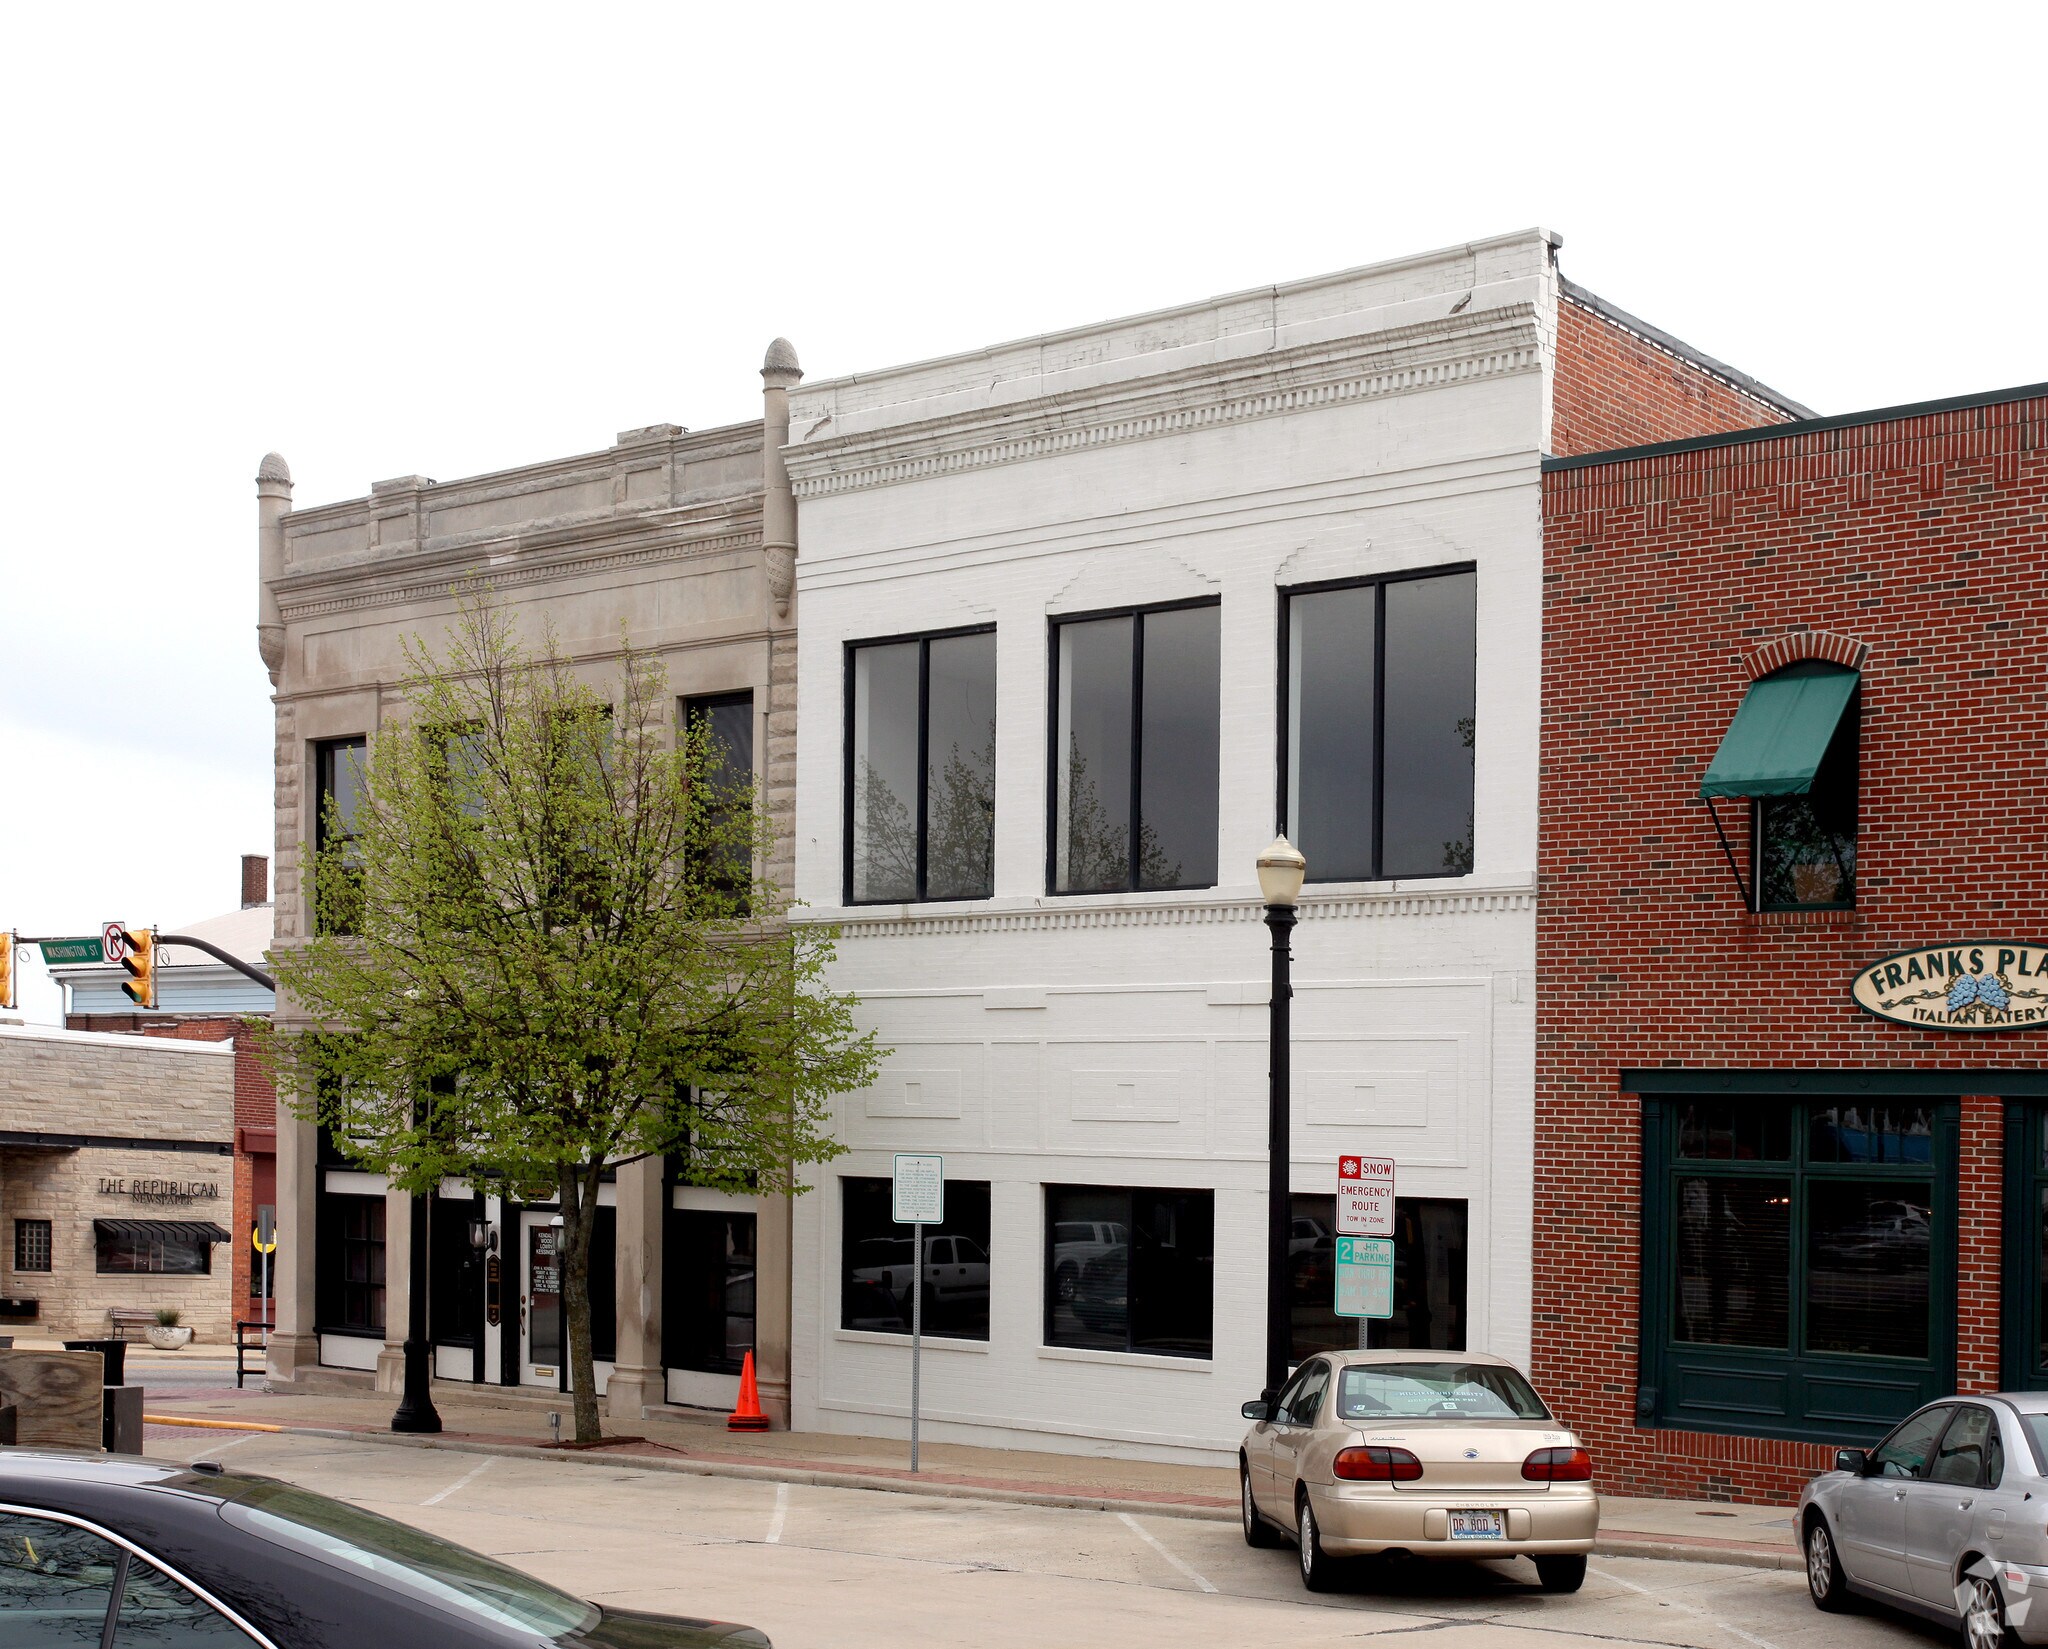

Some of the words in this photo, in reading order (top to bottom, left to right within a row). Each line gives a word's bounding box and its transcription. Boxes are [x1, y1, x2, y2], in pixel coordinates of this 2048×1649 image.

[46, 946, 88, 958] WASHINGTON
[89, 944, 98, 956] ST
[1869, 949, 1984, 996] FRANKS
[1912, 1007, 1976, 1024] ITALIAN
[1984, 1005, 2048, 1024] EATERY
[1363, 1163, 1391, 1175] SNOW
[99, 1178, 125, 1193] THE
[133, 1180, 218, 1197] REPUBLICAN
[1341, 1185, 1391, 1197] EMERGENCY
[132, 1194, 193, 1205] NEWSPAPER
[1352, 1201, 1379, 1212] ROUTE
[1369, 1216, 1385, 1224] ZONE
[1341, 1242, 1351, 1260] 2
[1366, 1243, 1379, 1252] HR
[1355, 1252, 1389, 1263] PARKING
[1453, 1518, 1465, 1531] DR
[1494, 1519, 1501, 1531] 5
